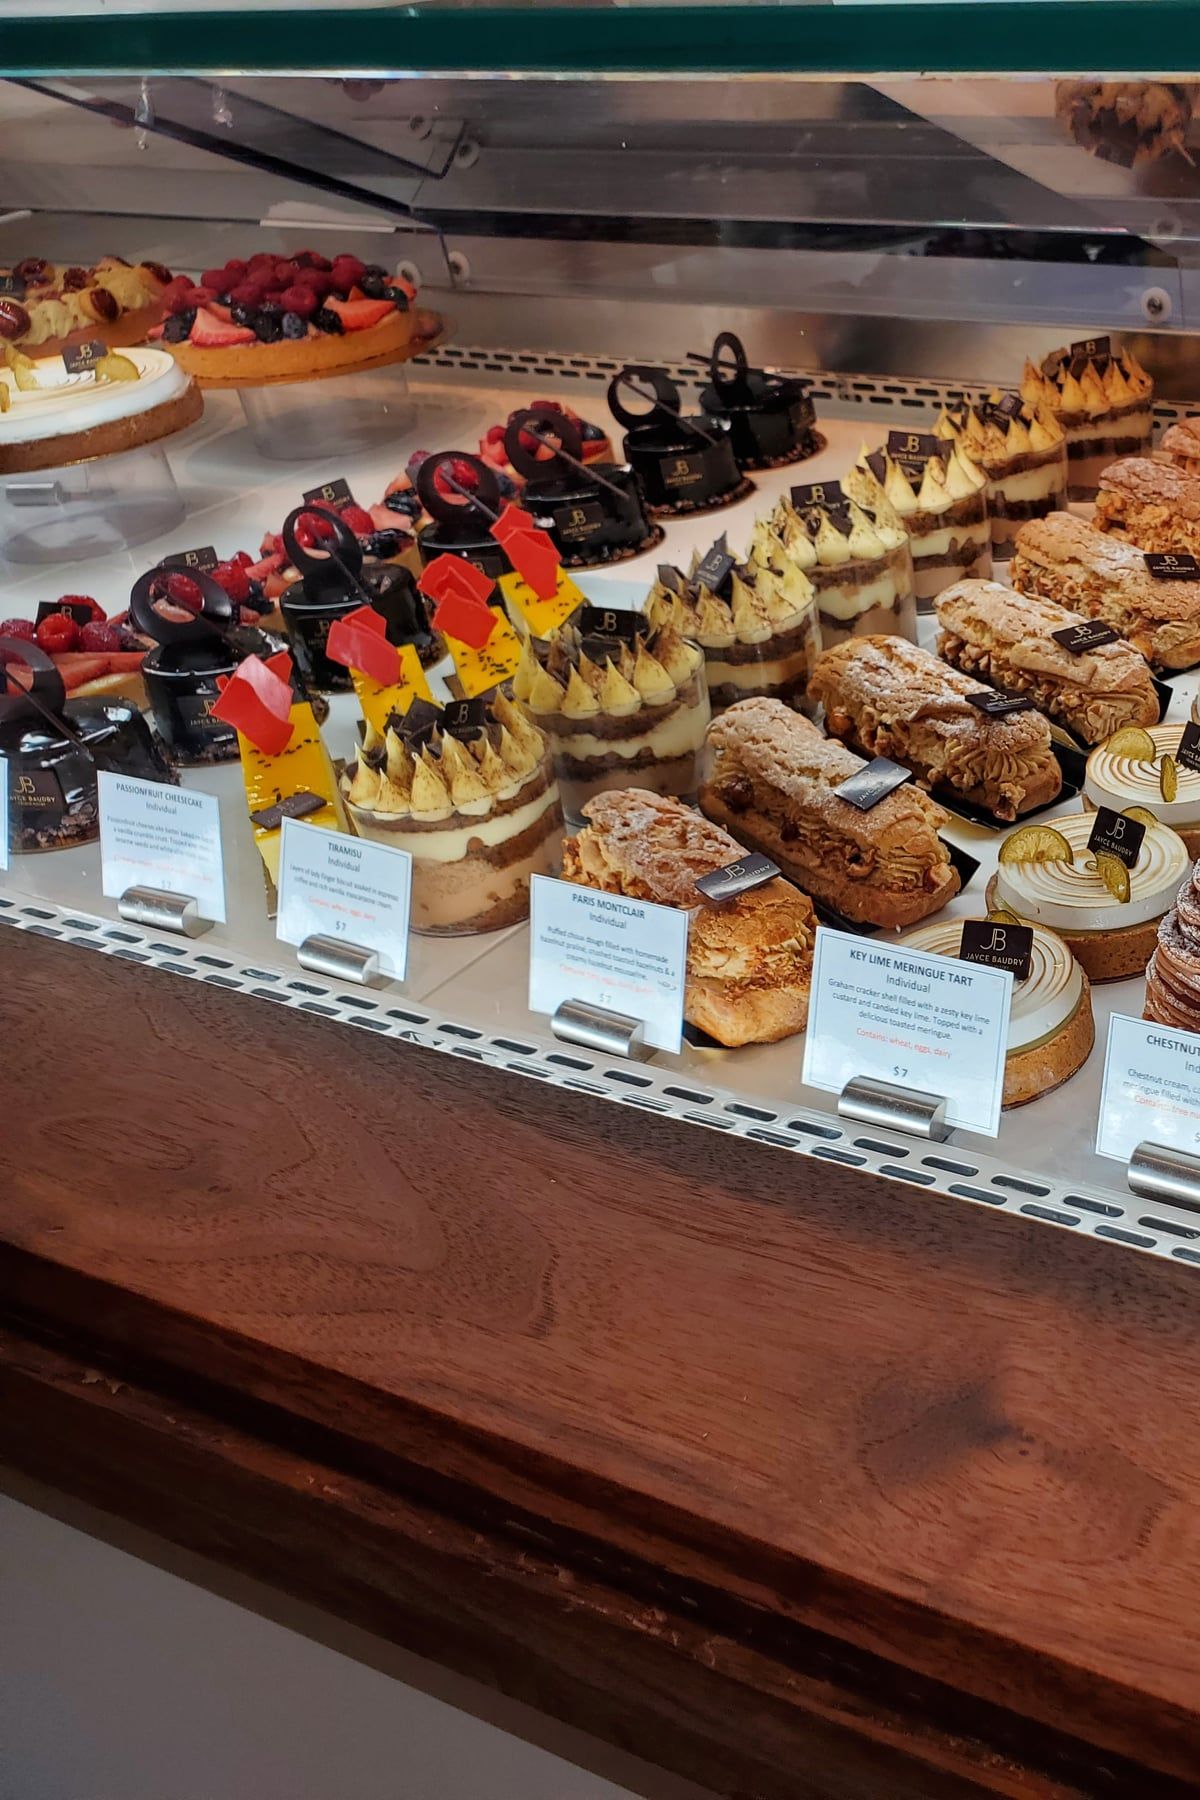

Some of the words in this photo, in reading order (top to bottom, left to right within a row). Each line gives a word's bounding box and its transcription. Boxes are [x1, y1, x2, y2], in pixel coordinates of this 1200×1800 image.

[328, 842, 361, 858] TIRAMISU
[572, 893, 594, 906] PARIS
[597, 899, 644, 918] MONTCLAIR
[850, 949, 867, 960] KEY
[869, 954, 891, 967] LIME
[893, 960, 945, 980] MERINGUE
[947, 972, 973, 986] TART
[966, 952, 990, 962] JAYCE
[992, 955, 1024, 966] BAUDRY
[886, 974, 930, 992] Individual
[828, 978, 854, 990] Graham
[855, 986, 880, 997] cracker
[881, 992, 897, 1001] shell
[898, 995, 916, 1006] filled
[917, 1002, 933, 1010] with
[940, 1007, 959, 1018] zesty
[960, 1011, 973, 1021] key
[974, 1013, 990, 1024] lime
[832, 992, 857, 1003] custard
[858, 999, 871, 1007] and
[872, 1003, 898, 1014] candied
[900, 1008, 912, 1019] key
[932, 1016, 959, 1029] Topped
[858, 1010, 888, 1023] delicious
[889, 1018, 915, 1030] toasted
